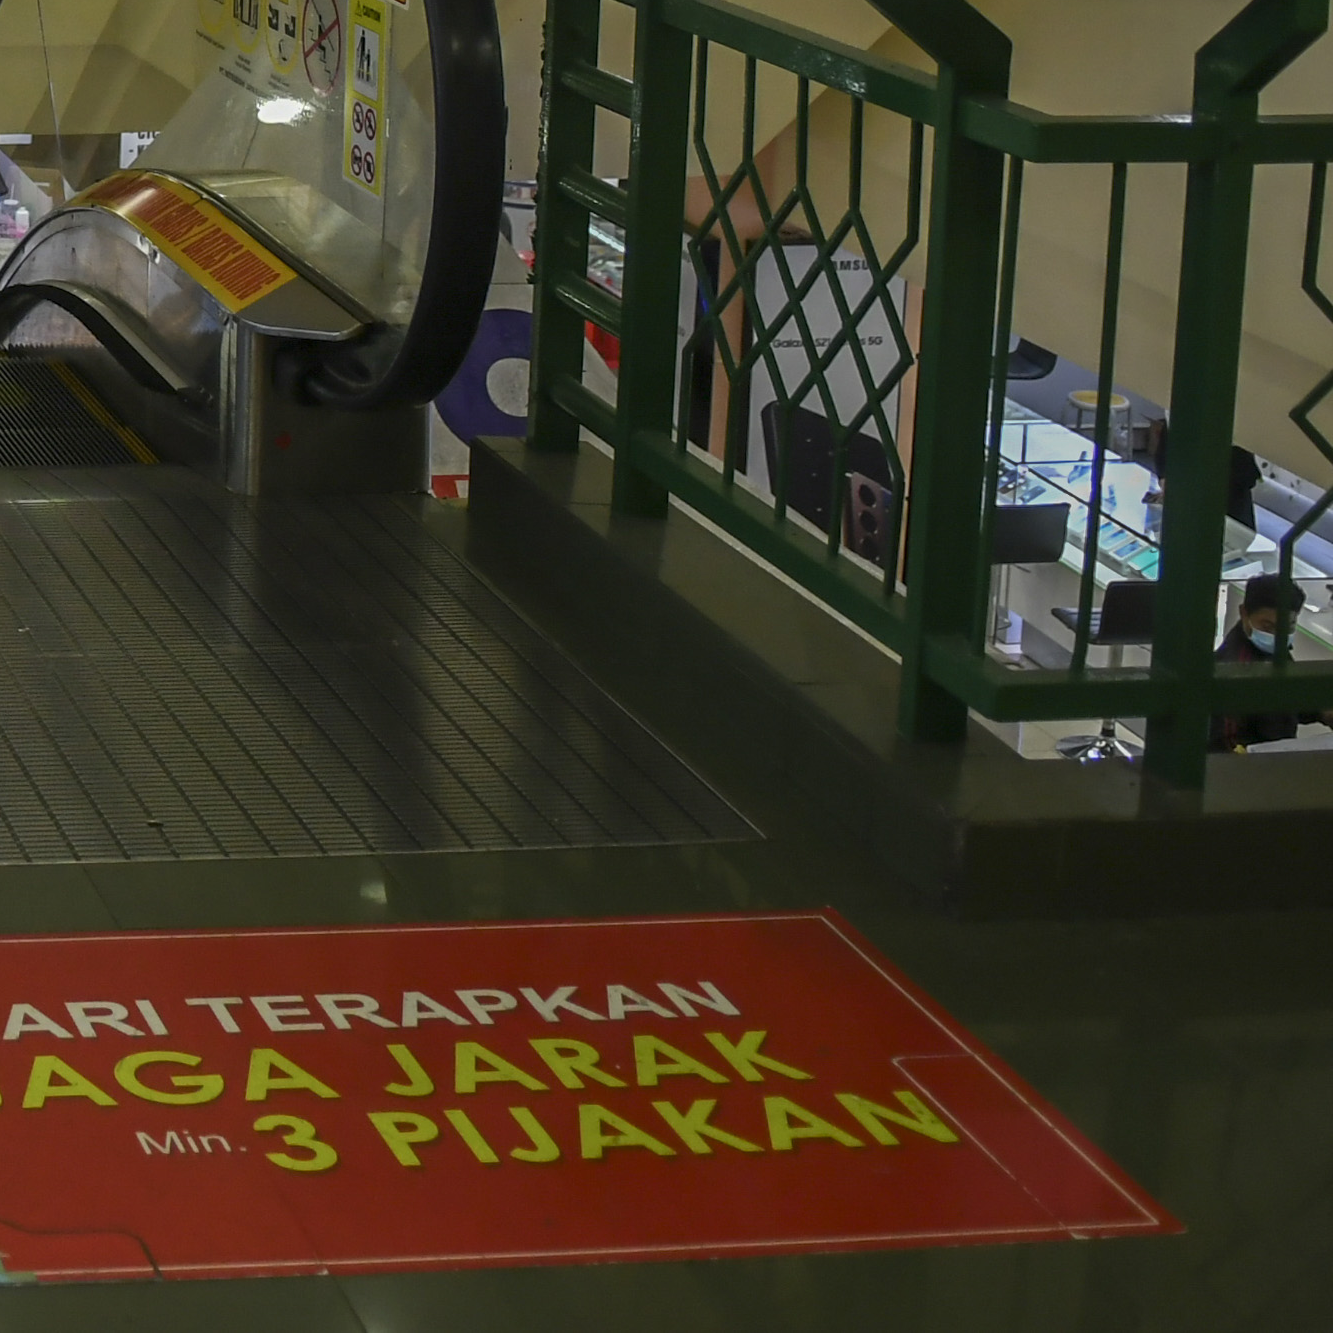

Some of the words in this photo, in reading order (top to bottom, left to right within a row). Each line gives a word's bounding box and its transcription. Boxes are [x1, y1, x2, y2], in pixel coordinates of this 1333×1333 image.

[868, 336, 883, 346] 5G
[184, 981, 740, 1033] TERAPKAN
[385, 1030, 811, 1097] JARAK
[136, 1131, 248, 1156] Min.
[253, 1114, 338, 1172] 3
[367, 1090, 958, 1167] PIJAKAN
